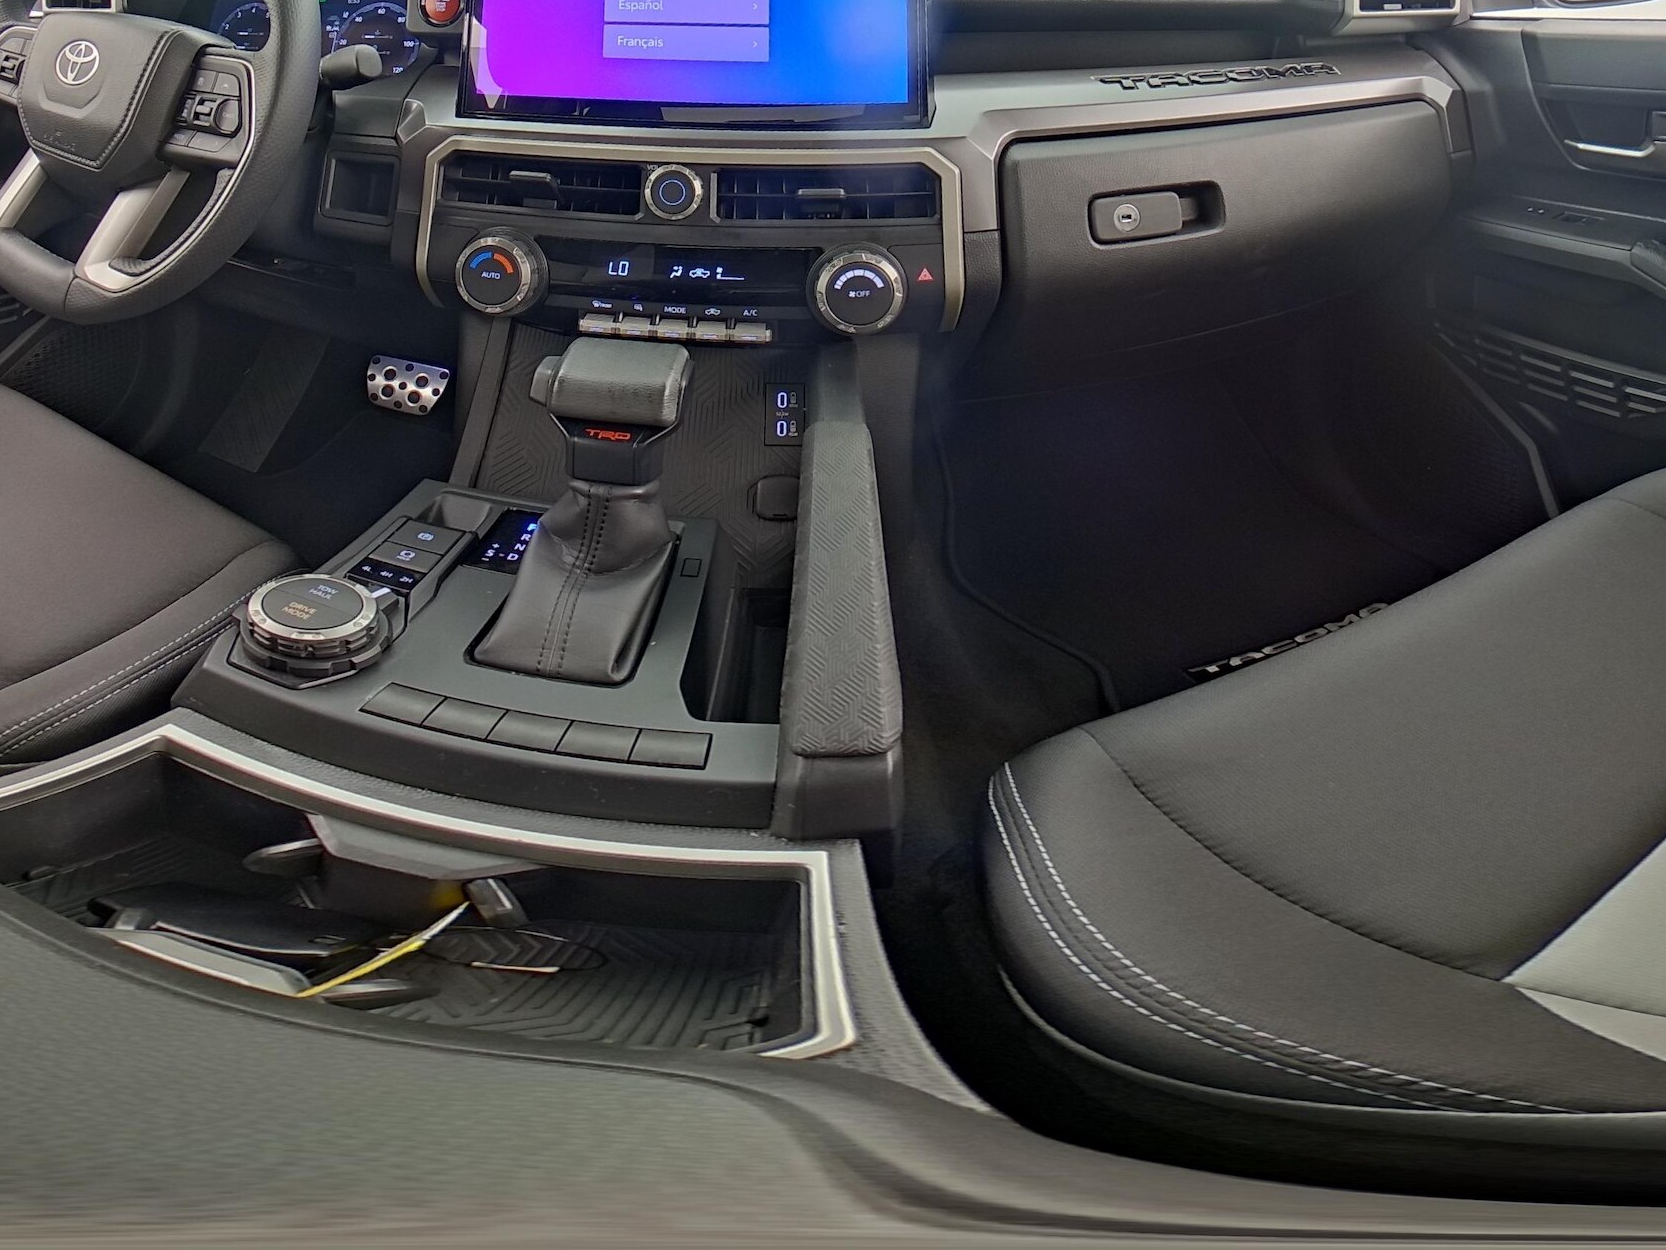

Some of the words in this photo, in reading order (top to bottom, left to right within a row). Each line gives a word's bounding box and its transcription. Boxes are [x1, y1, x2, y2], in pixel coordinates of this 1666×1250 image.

[618, 0, 663, 12] Español
[403, 40, 414, 48] 100
[617, 35, 664, 49] Français
[1092, 61, 1340, 91] TACOMA
[481, 271, 501, 280] AUTO
[855, 290, 871, 298] OFF
[664, 306, 687, 314] MODE
[743, 309, 758, 317] A/C
[585, 429, 631, 440] TRD
[520, 533, 532, 541] R
[514, 543, 526, 551] N
[485, 549, 495, 557] S
[379, 570, 393, 578] 4H
[399, 575, 413, 583] 2H
[317, 584, 338, 594] TOW
[309, 589, 333, 599] HAUL
[289, 601, 316, 614] DRIVE
[282, 606, 310, 620] MODE
[1188, 603, 1388, 672] TACOMA
